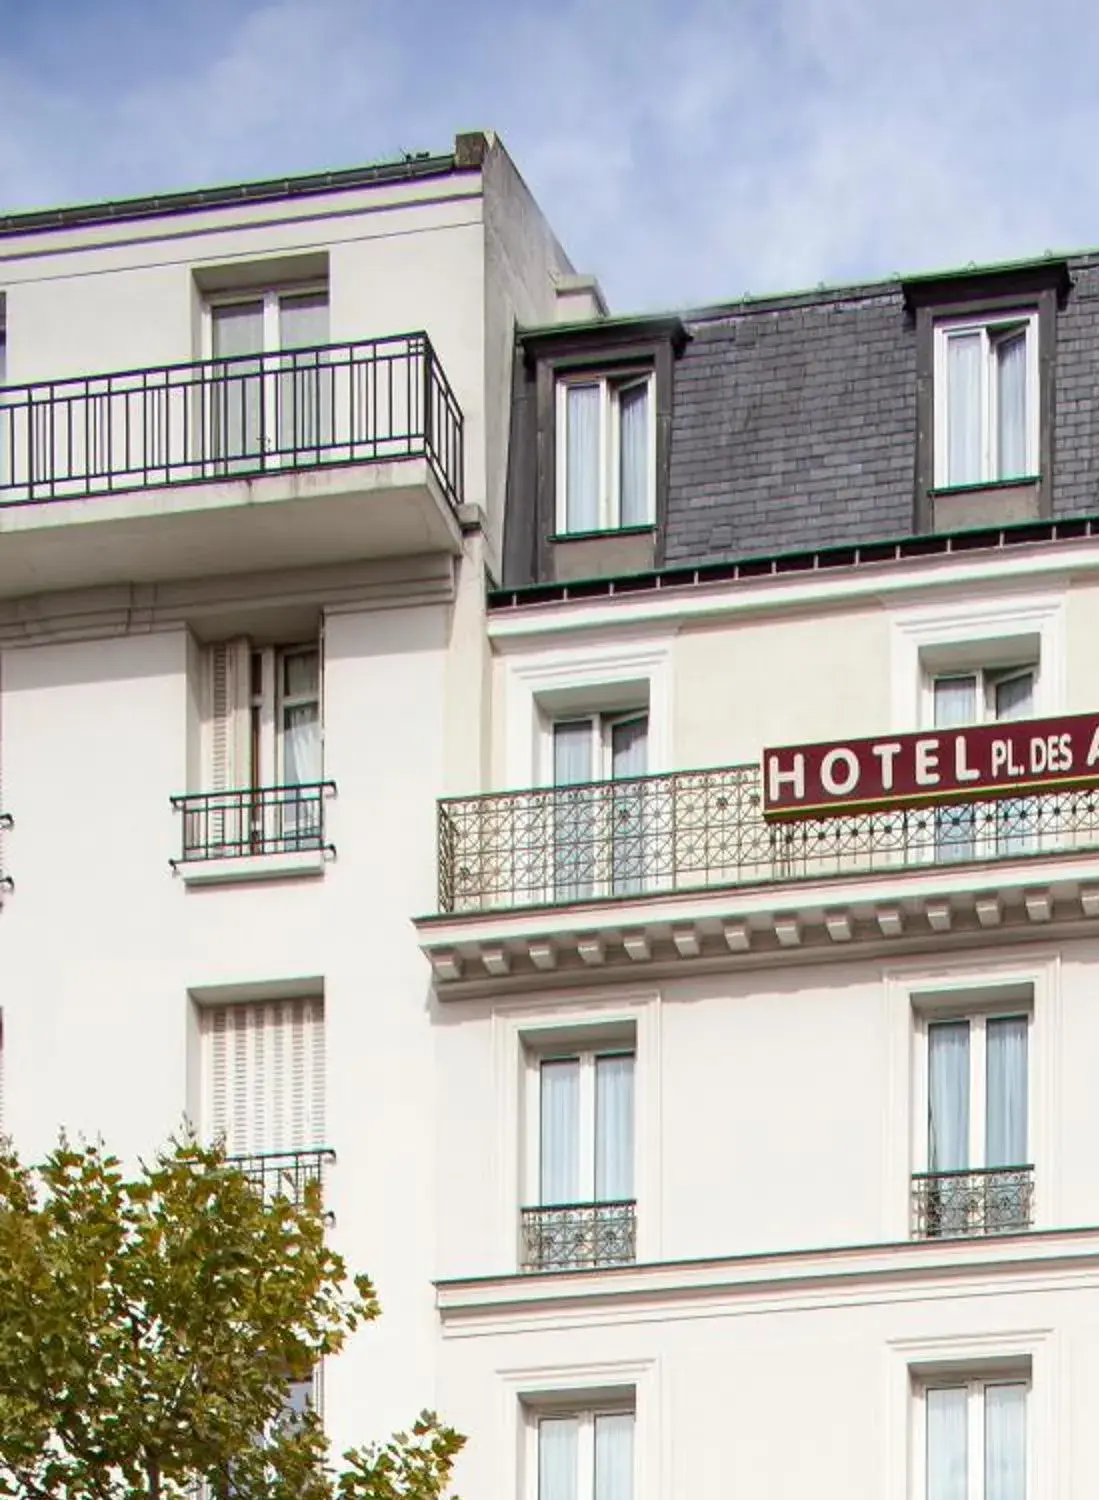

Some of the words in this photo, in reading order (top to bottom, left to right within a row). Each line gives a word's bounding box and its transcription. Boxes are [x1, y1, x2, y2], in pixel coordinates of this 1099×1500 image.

[768, 735, 980, 802] HOTEL
[991, 739, 1025, 778] PL.
[1030, 733, 1073, 774] DES
